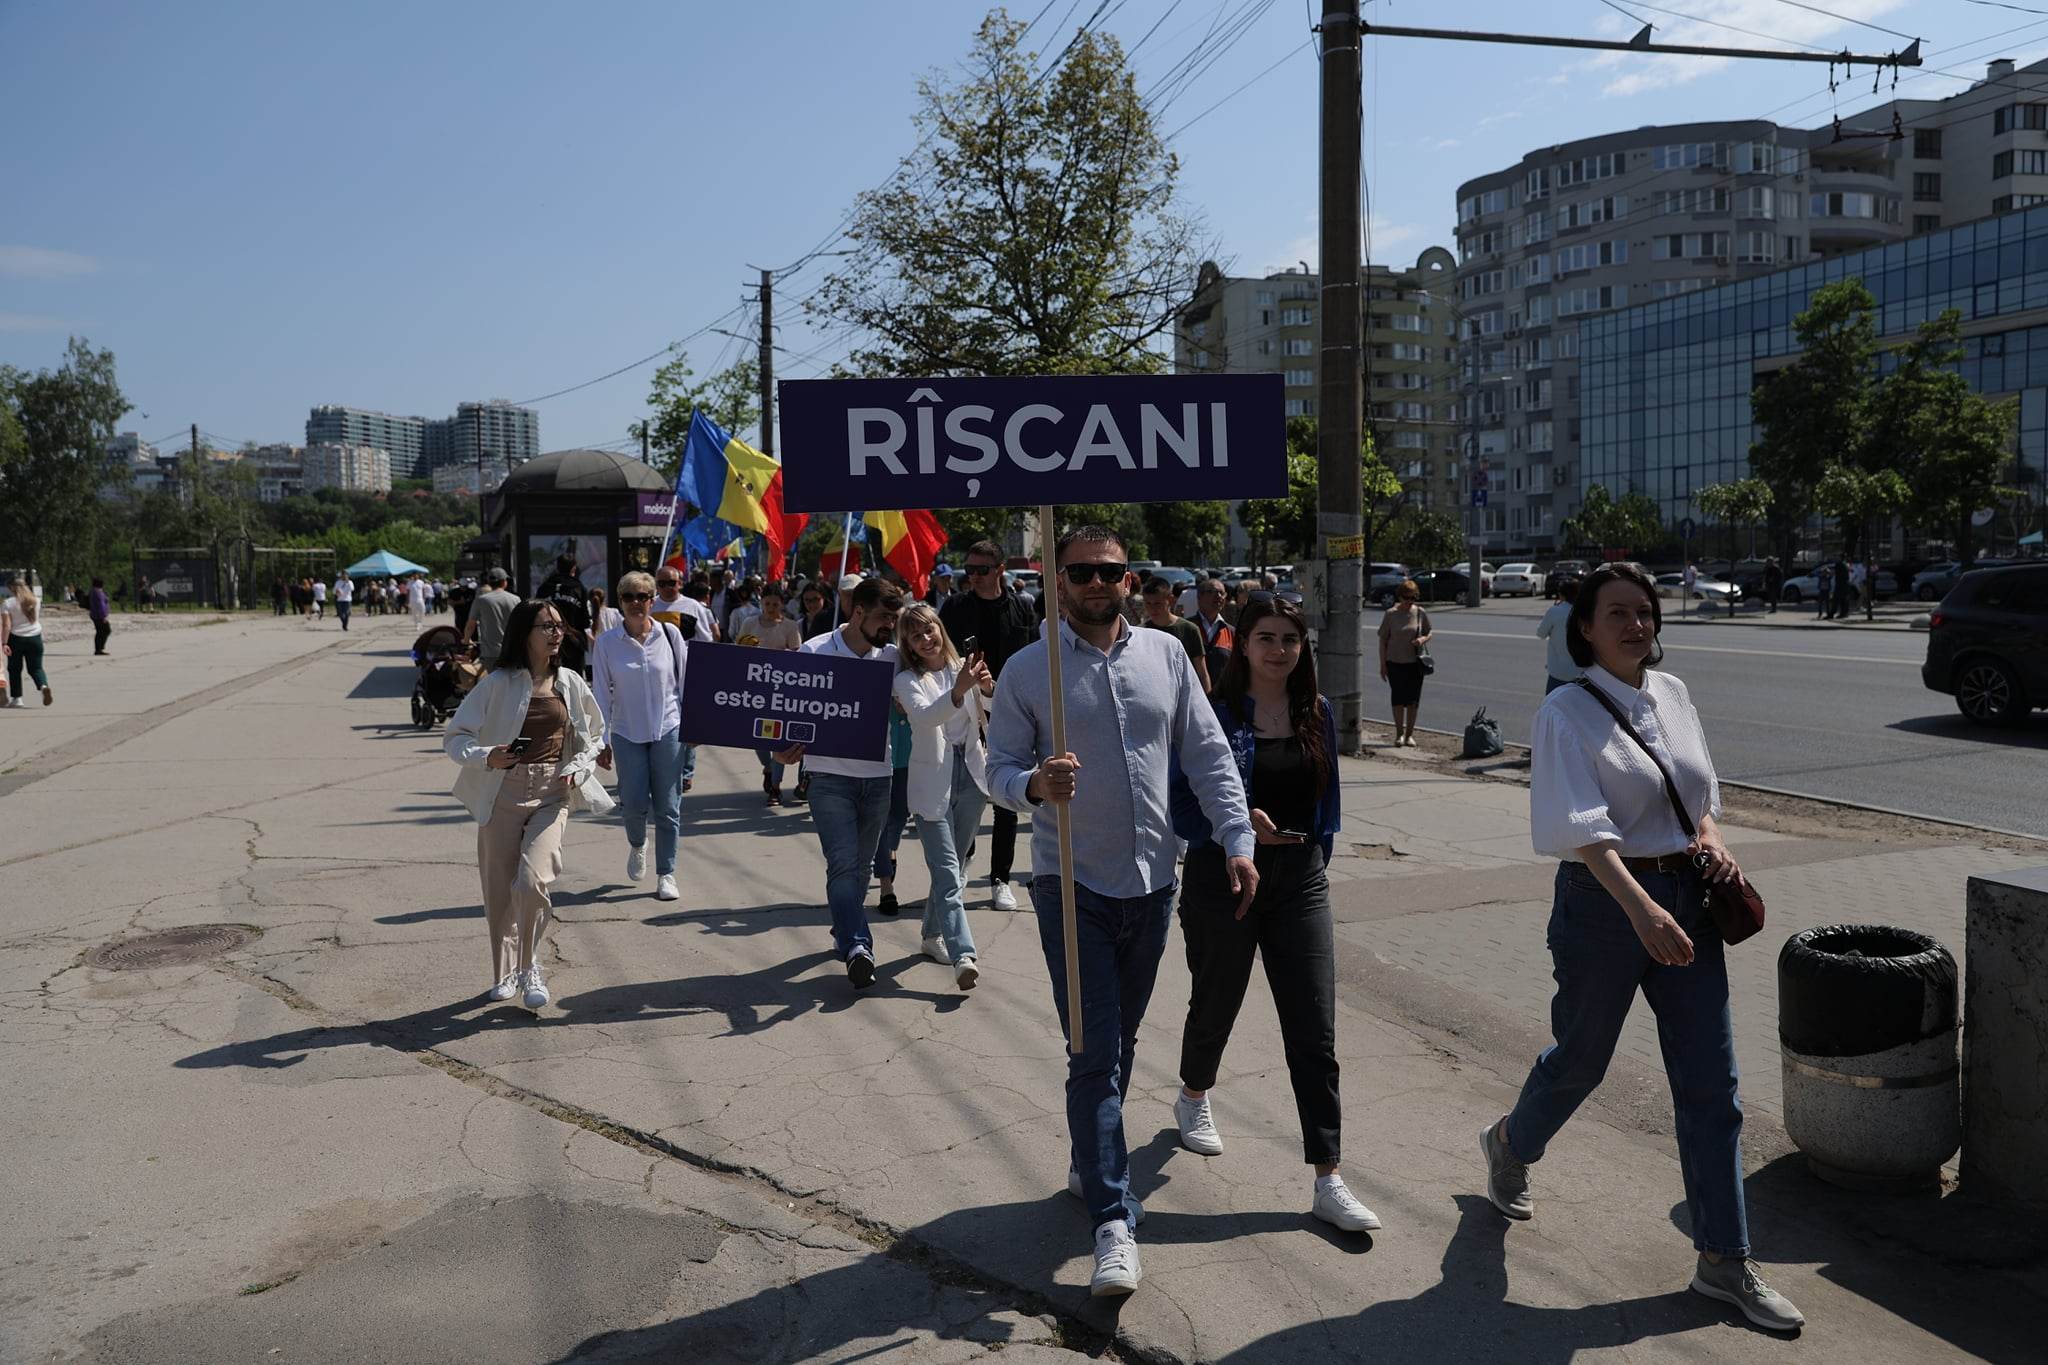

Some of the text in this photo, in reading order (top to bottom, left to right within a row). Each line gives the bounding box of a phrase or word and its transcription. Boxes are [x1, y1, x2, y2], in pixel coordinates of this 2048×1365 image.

[847, 387, 1229, 498] RÎȘCANI
[643, 503, 677, 515] moldce
[747, 663, 834, 690] Rîșcani
[714, 690, 860, 720] este Europa!
